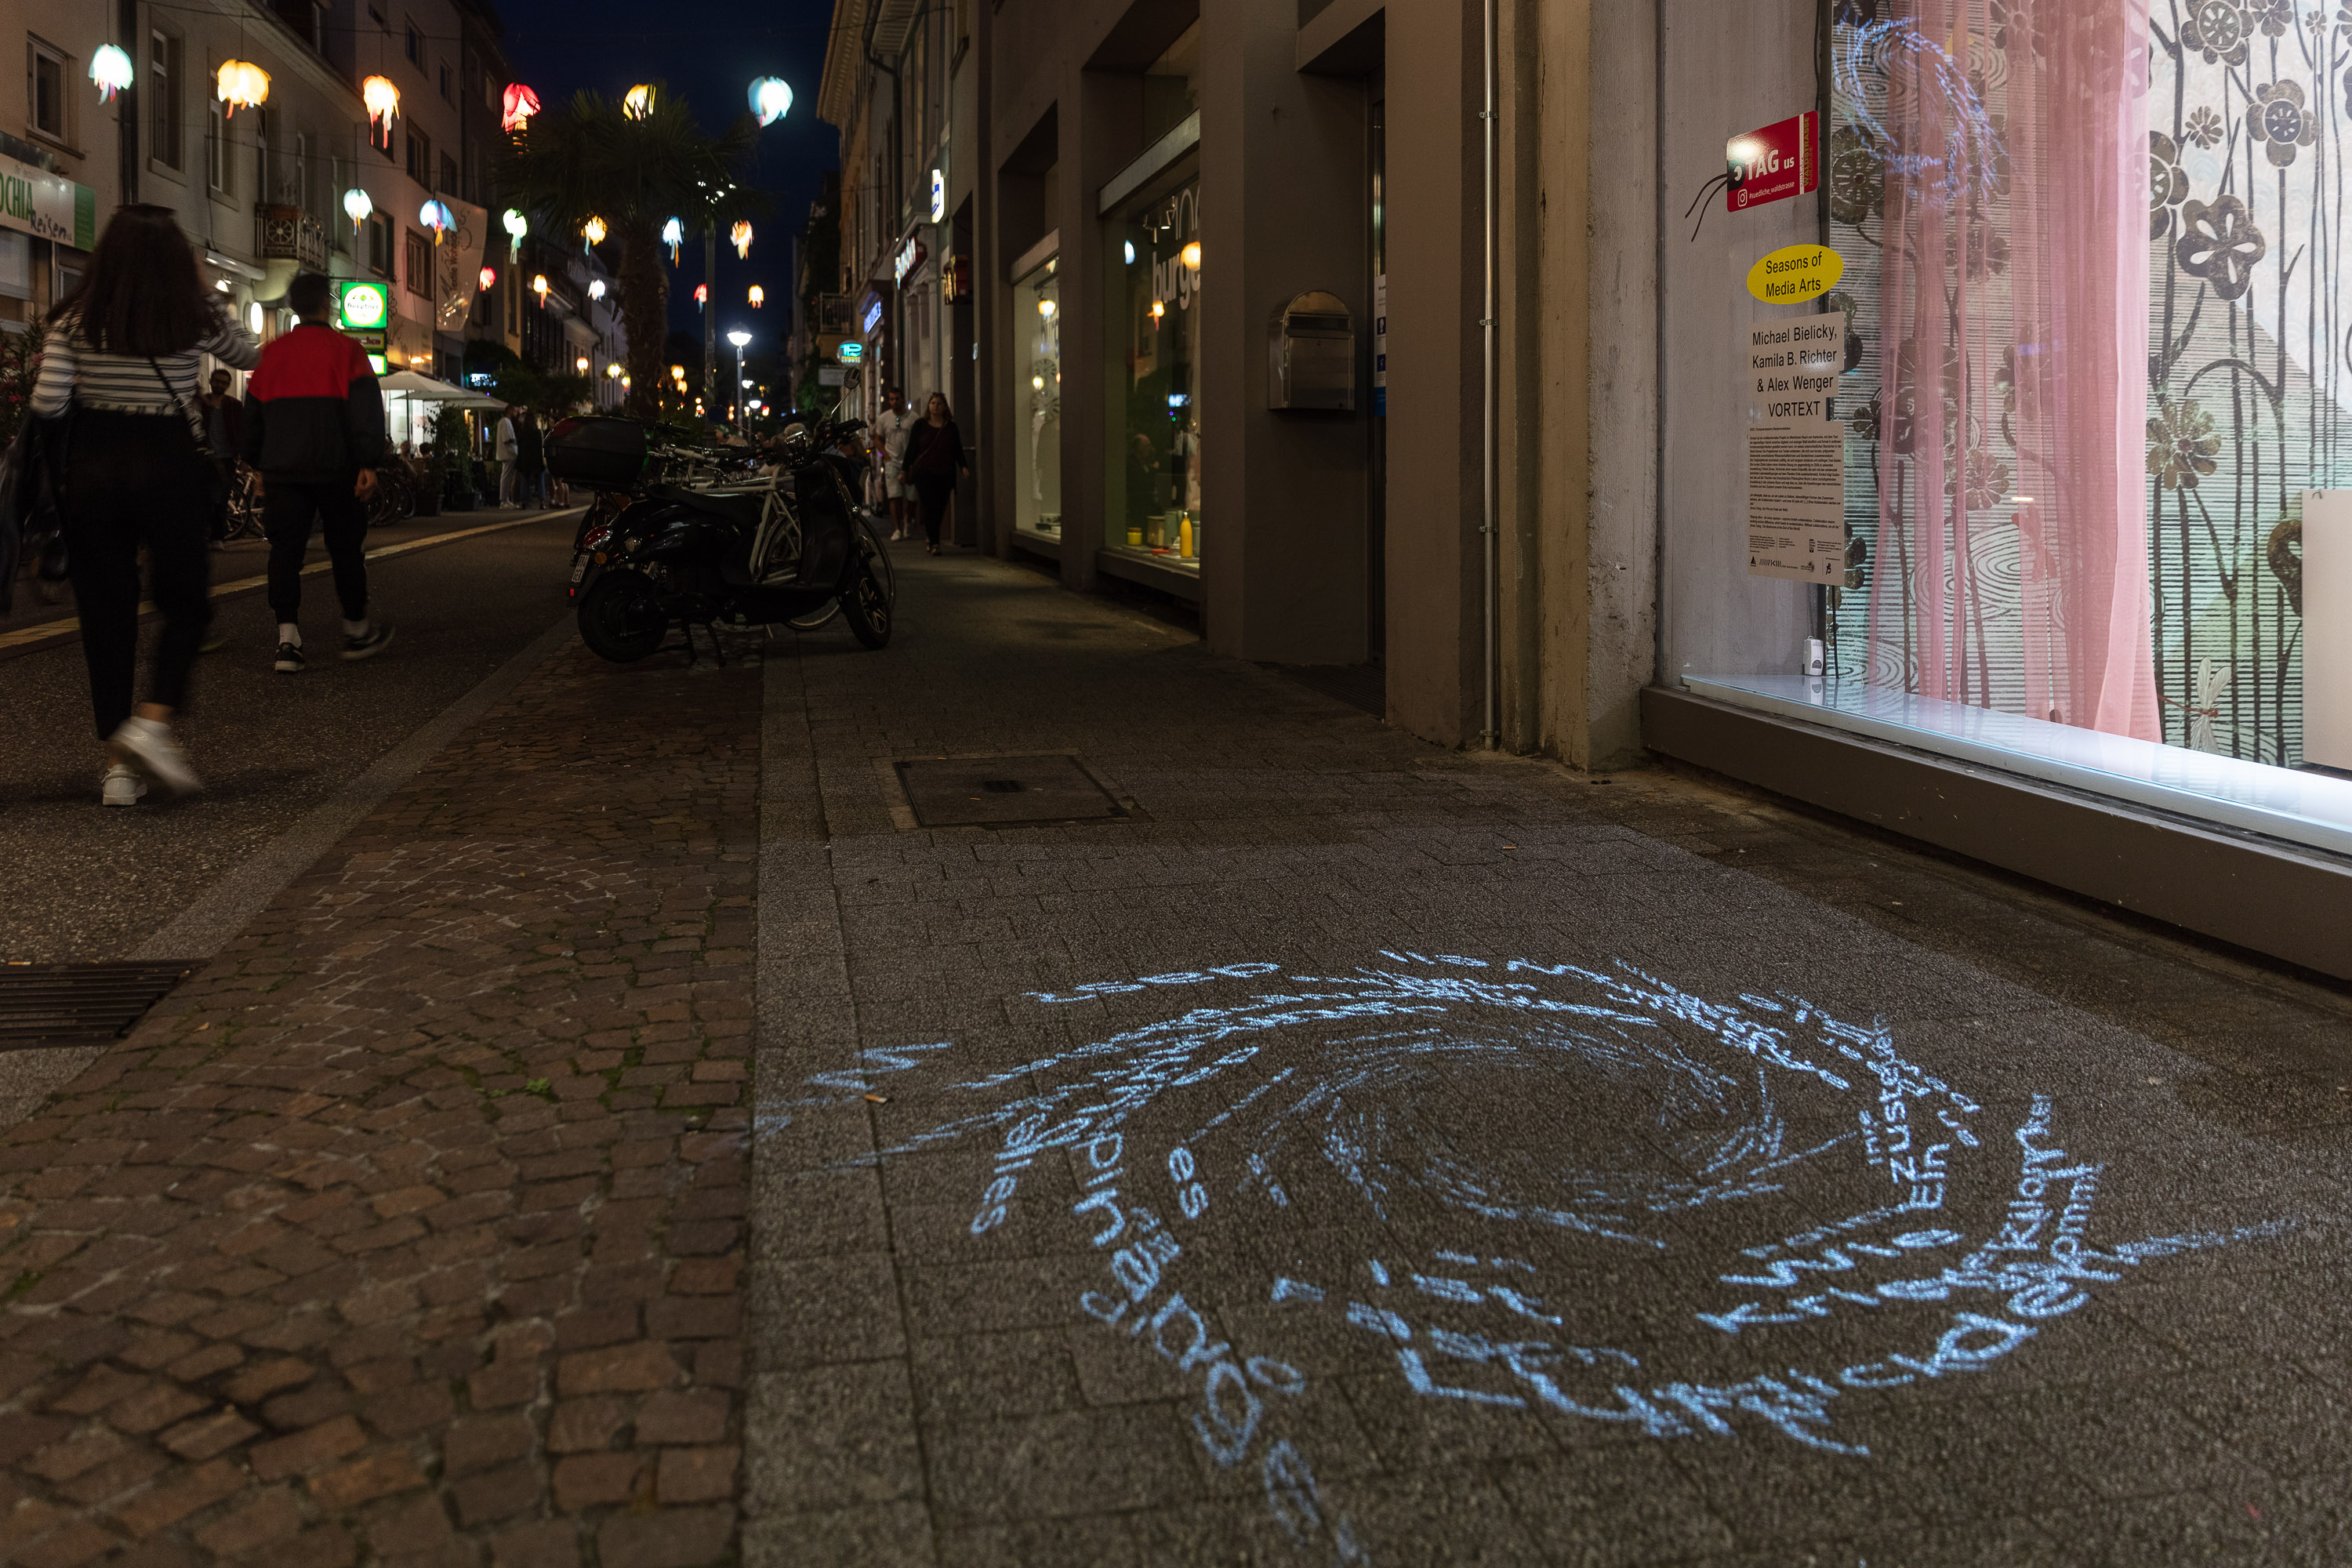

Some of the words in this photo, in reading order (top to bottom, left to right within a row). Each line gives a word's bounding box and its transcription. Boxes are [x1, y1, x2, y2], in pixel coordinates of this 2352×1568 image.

[1745, 149, 1780, 181] TAG
[1784, 156, 1795, 169] us
[1766, 256, 1809, 274] Seasons
[1811, 252, 1823, 267] of
[1766, 280, 1796, 298] Media
[1799, 278, 1822, 293] Arts
[1752, 328, 1790, 346] Michael
[1794, 324, 1838, 342] Bielicky,
[1752, 353, 1784, 369] Kamila
[1788, 351, 1798, 366] B.
[1799, 349, 1838, 365] Richter
[1757, 379, 1764, 393] &
[1768, 377, 1789, 392] Alex
[1793, 376, 1834, 393] Wenger
[1768, 401, 1821, 417] VORTEXT
